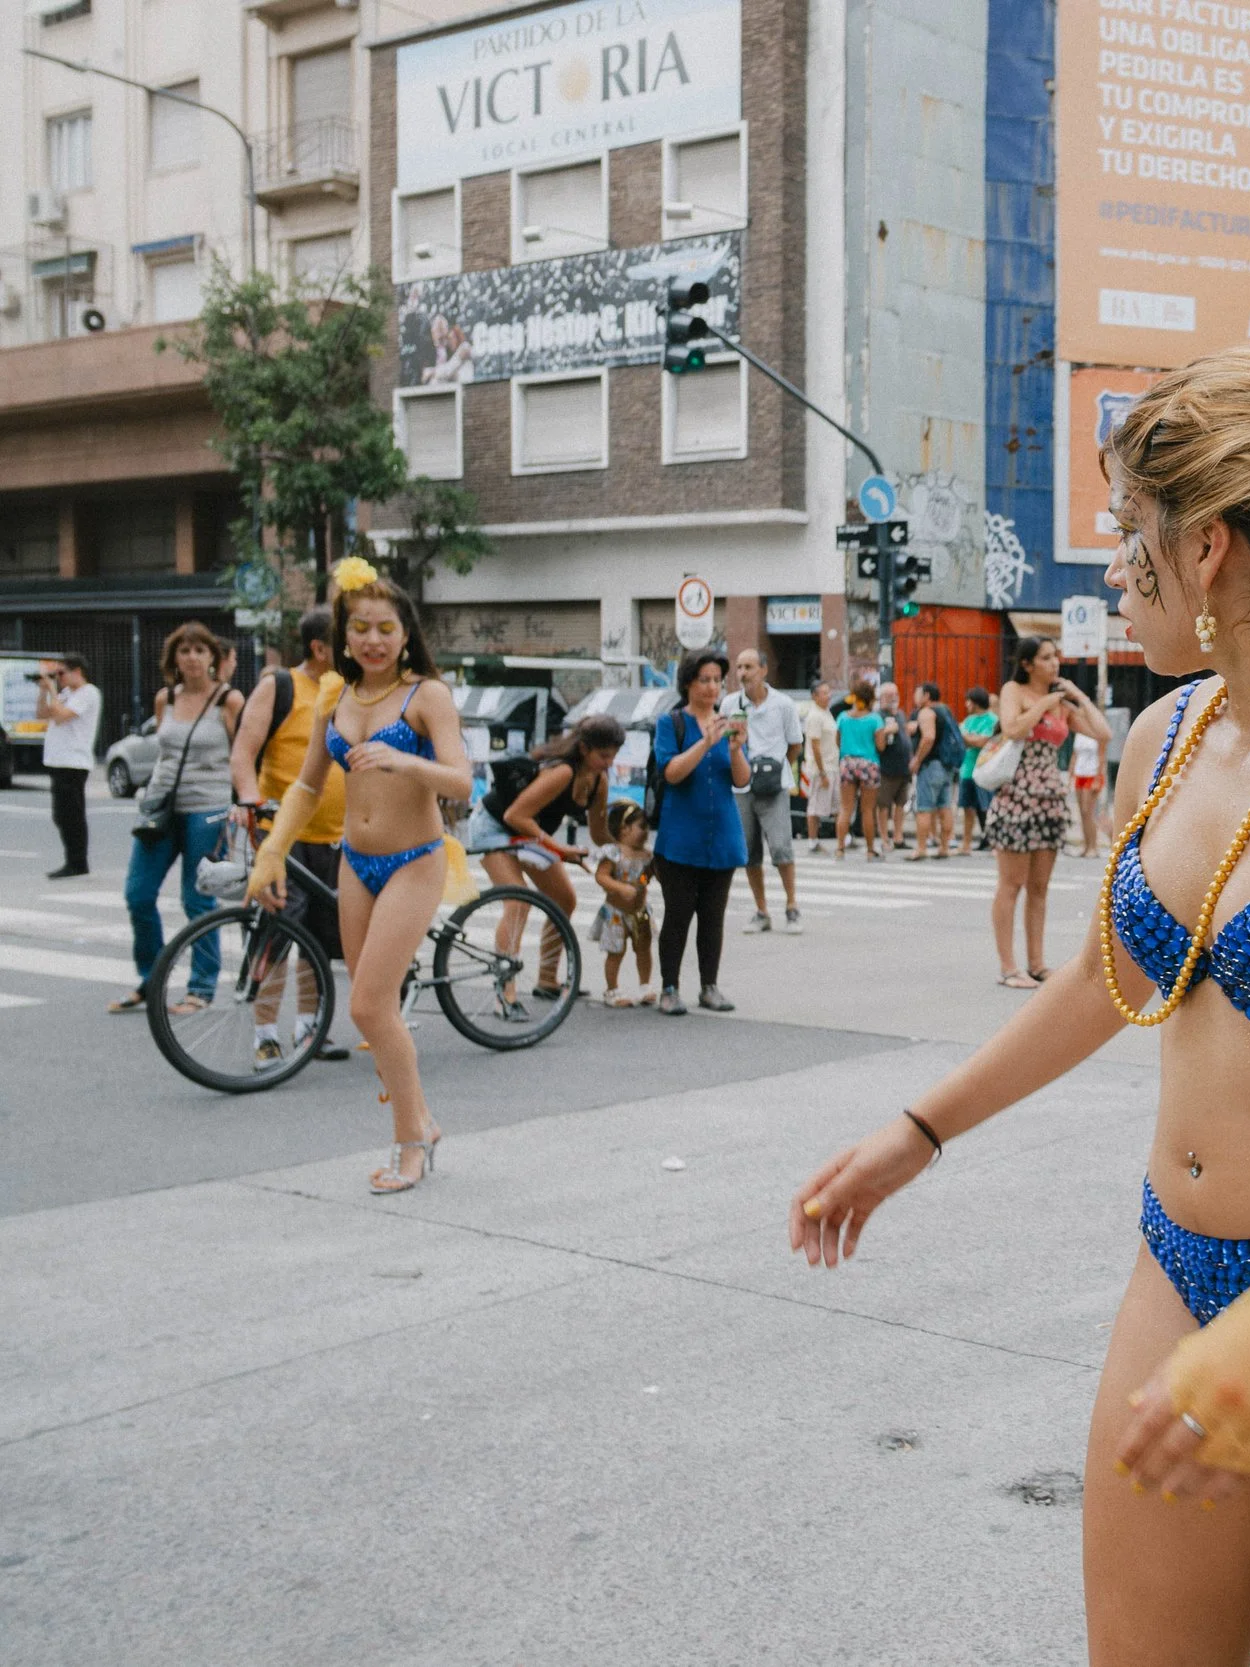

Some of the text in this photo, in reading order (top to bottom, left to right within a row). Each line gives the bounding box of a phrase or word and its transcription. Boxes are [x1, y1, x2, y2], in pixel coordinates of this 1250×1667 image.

[474, 0, 648, 60] PARTIDO DE LA
[1100, 17, 1157, 48] UNA
[1099, 50, 1245, 95] PEDIRLA ES
[1098, 82, 1134, 110] TU
[481, 116, 636, 161] LOCAL CENTRAL
[1098, 115, 1238, 157] Y EXIGIRLA
[1098, 148, 1134, 176] TU
[471, 320, 525, 358] Casa
